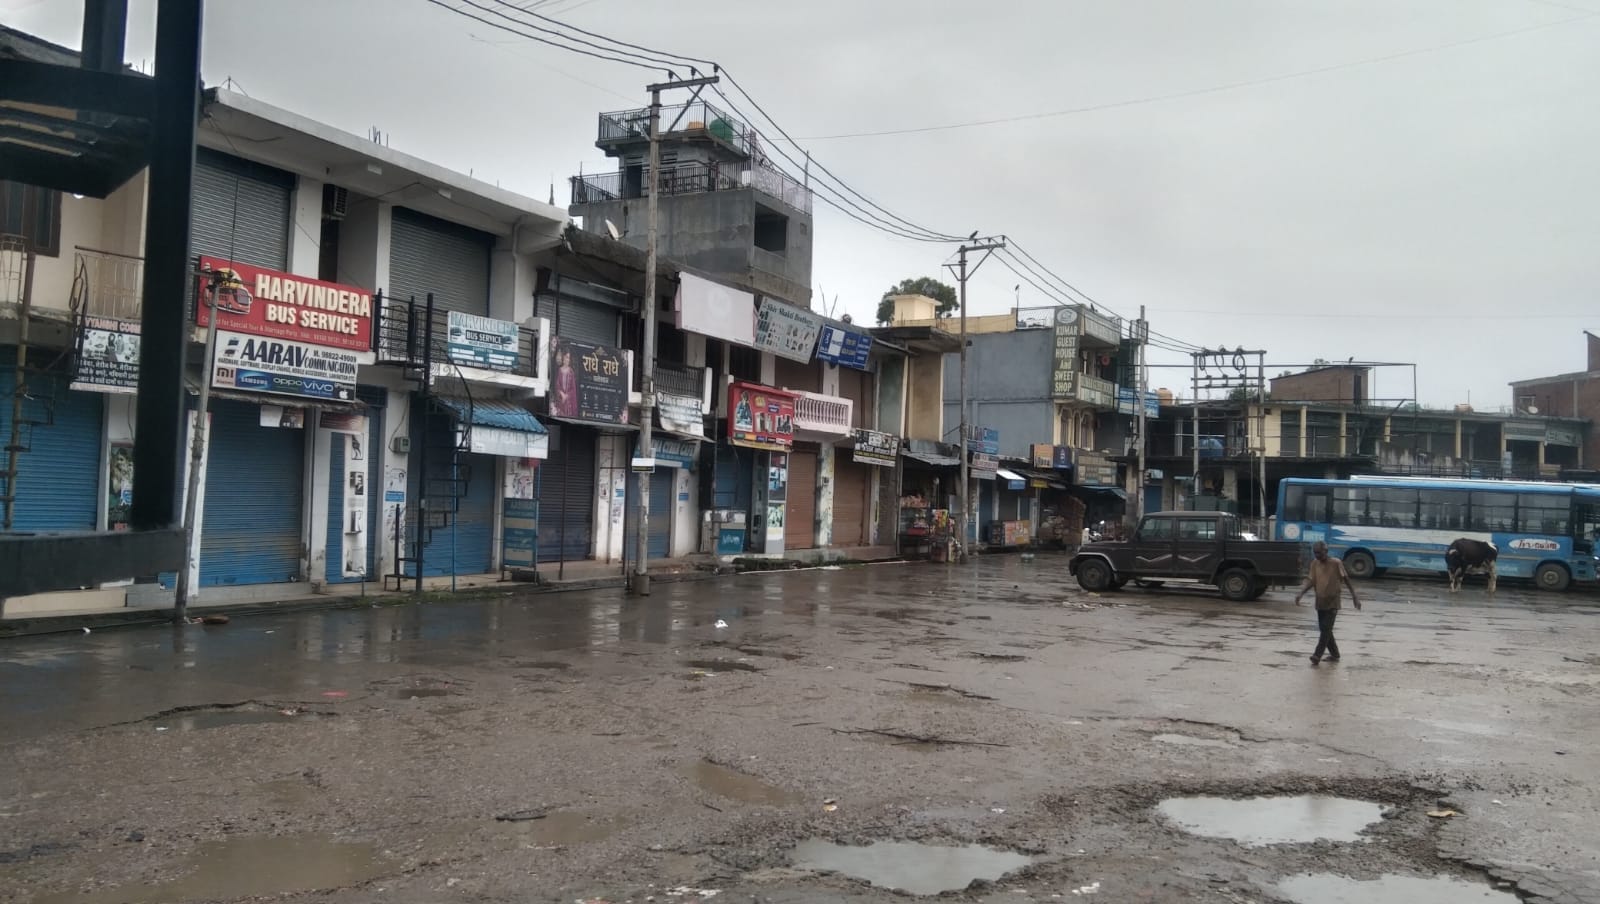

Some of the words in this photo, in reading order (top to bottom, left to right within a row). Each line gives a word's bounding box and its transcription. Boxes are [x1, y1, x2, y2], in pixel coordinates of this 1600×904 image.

[255, 274, 370, 317] HARVINDERA
[266, 304, 297, 325] BUS
[300, 309, 359, 335] SERVICE
[1056, 325, 1078, 336] KUMAR
[466, 331, 478, 340] BUS
[479, 333, 502, 344] SERVICE
[1057, 336, 1075, 347] GUEST
[240, 338, 309, 368] AARAV
[1055, 347, 1076, 358] HOUSE
[304, 356, 356, 375] COMMUNICATION
[582, 352, 599, 373] राधे
[602, 356, 619, 377] राधे
[1059, 359, 1072, 370] And
[240, 377, 268, 385] SAMSUNG
[1054, 370, 1074, 381] SWEET
[273, 377, 302, 387] oppo
[303, 377, 334, 392] vivo
[1054, 381, 1072, 393] SHOP
